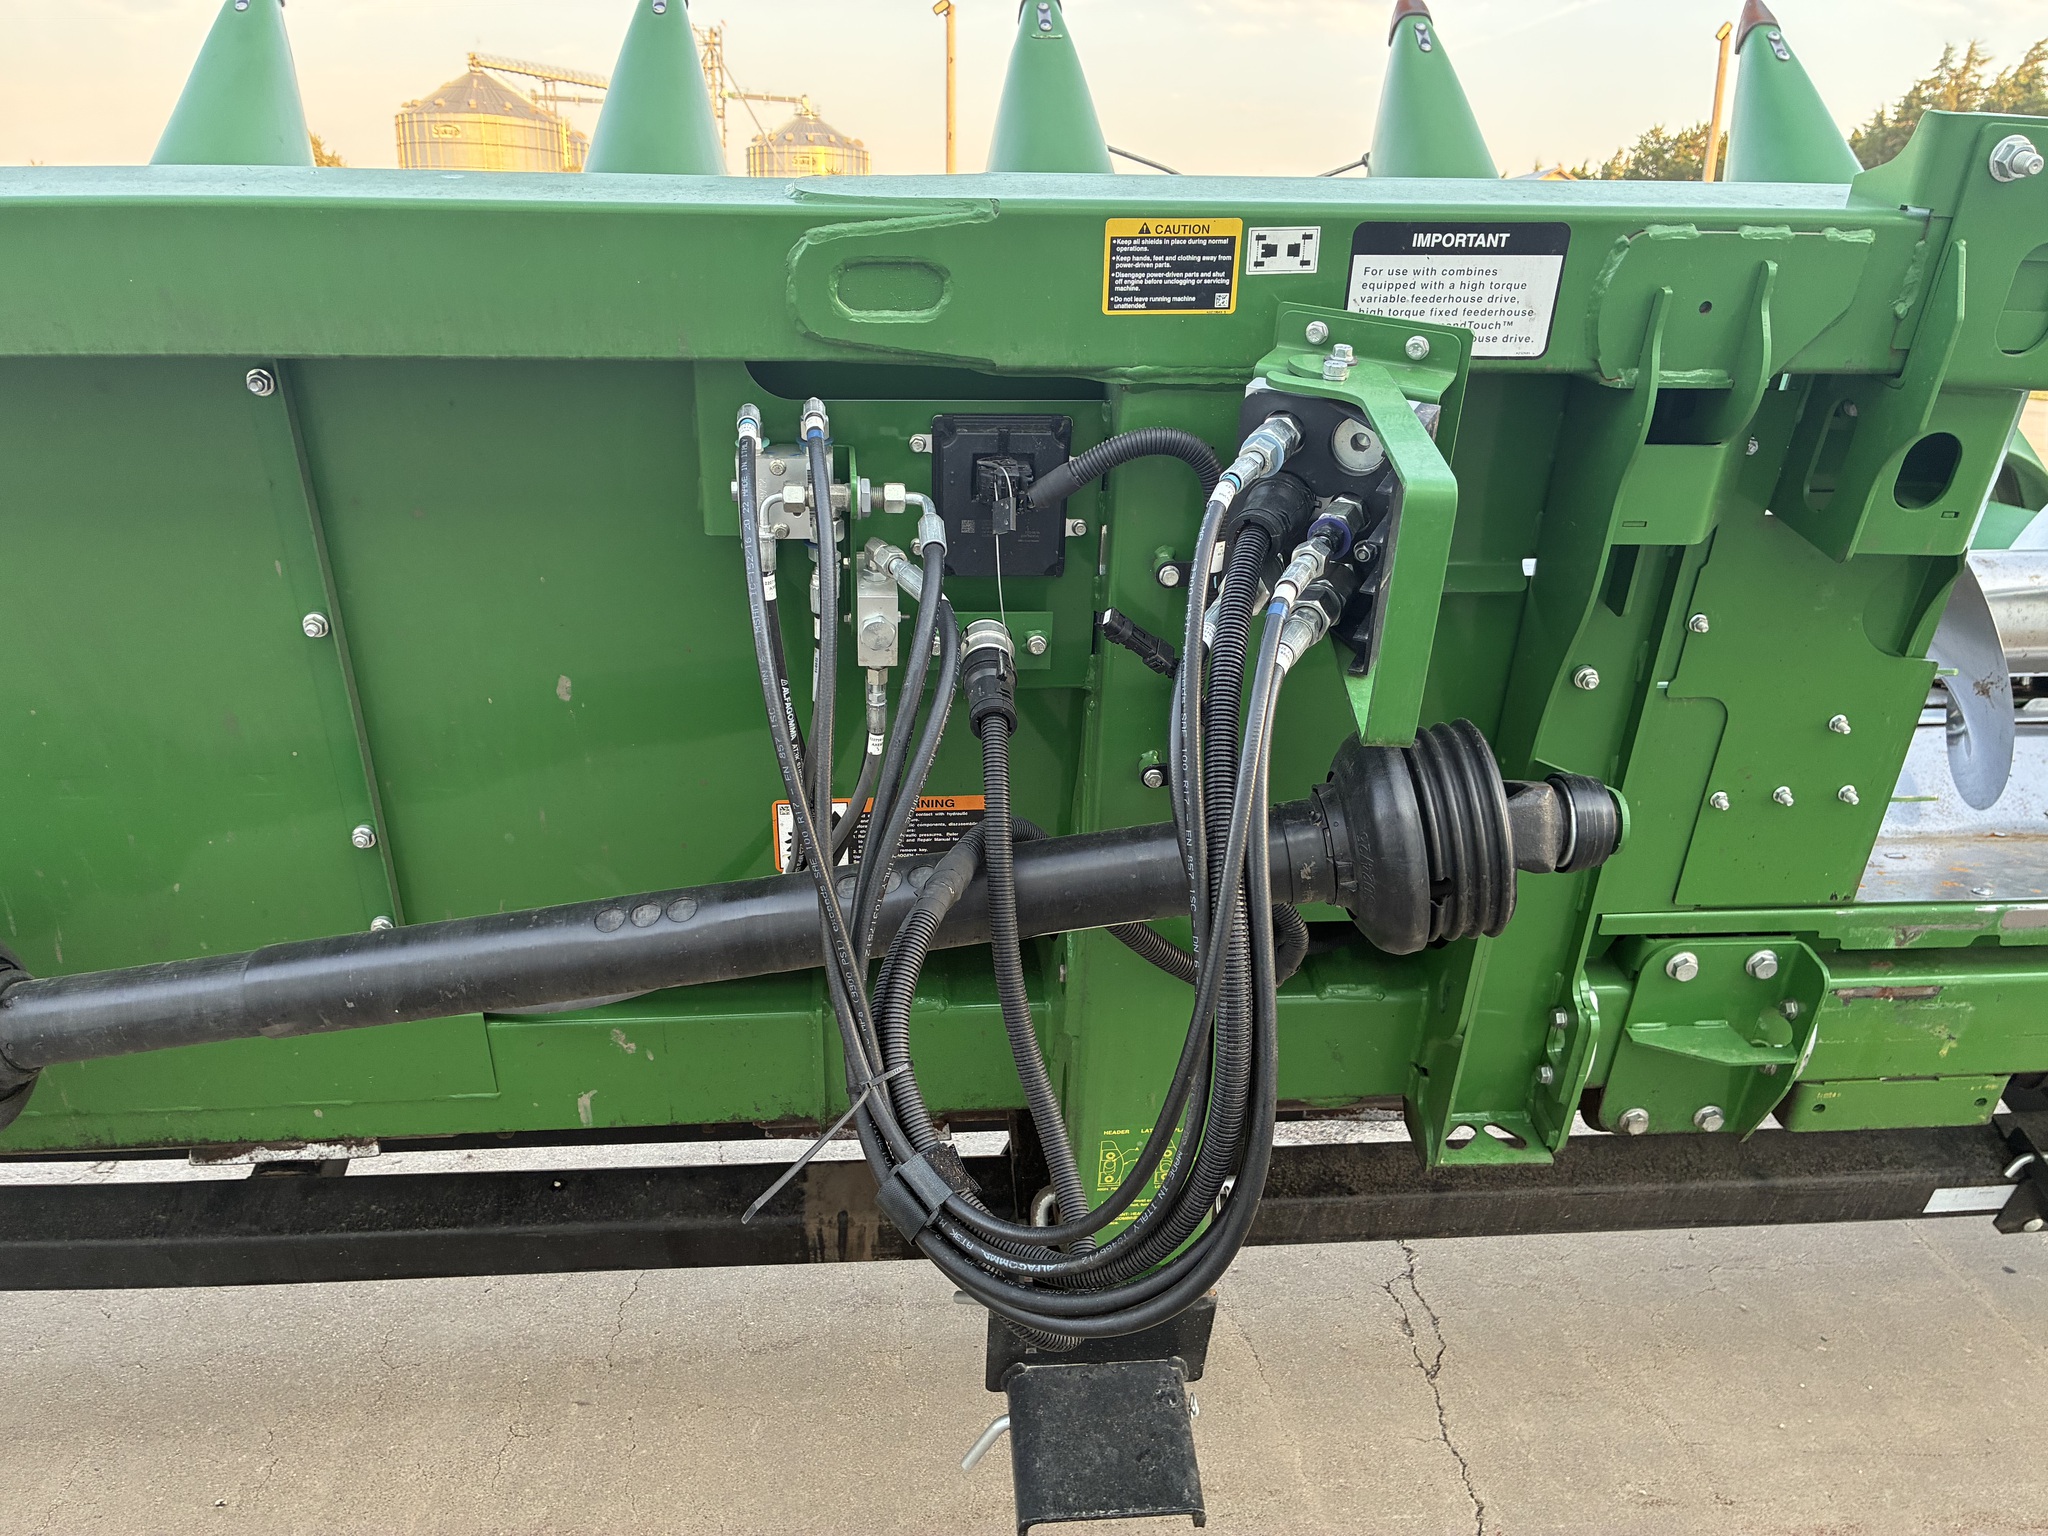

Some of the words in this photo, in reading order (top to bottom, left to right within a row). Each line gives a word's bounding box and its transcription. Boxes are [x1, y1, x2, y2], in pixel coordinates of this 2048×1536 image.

[1155, 224, 1210, 234] CAUTION
[1412, 233, 1510, 248] IMPORTANT
[1364, 267, 1383, 276] For
[1387, 268, 1408, 276] use
[1413, 267, 1437, 276] with
[1441, 267, 1498, 276] combines
[1362, 281, 1416, 290] equipped
[1420, 281, 1445, 290] with
[1449, 282, 1455, 290] a
[1460, 281, 1485, 291] high
[1489, 281, 1527, 291] torque
[1360, 294, 1407, 303] variable
[1411, 294, 1483, 303] feederhouse
[1487, 294, 1520, 304] drive,
[1388, 308, 1425, 317] torque
[1430, 308, 1458, 317] fixed
[1463, 308, 1534, 317] feederhouse
[1502, 334, 1534, 343] drive.
[741, 461, 748, 472] IN
[781, 686, 798, 741] ALFAGOMMA
[1181, 748, 1189, 771] 100
[783, 766, 792, 781] EN
[1182, 780, 1190, 806] R17
[915, 799, 955, 808] NING
[801, 831, 813, 850] 100
[1186, 830, 1193, 847] EN
[809, 858, 822, 879] SAE
[1187, 855, 1195, 880] 857
[1192, 936, 1200, 953] DN
[1168, 1152, 1184, 1180] MADE
[1158, 1187, 1169, 1199] IN
[1134, 1203, 1158, 1233] ITALY
[979, 1249, 1057, 1273] ALFAGOMMA
